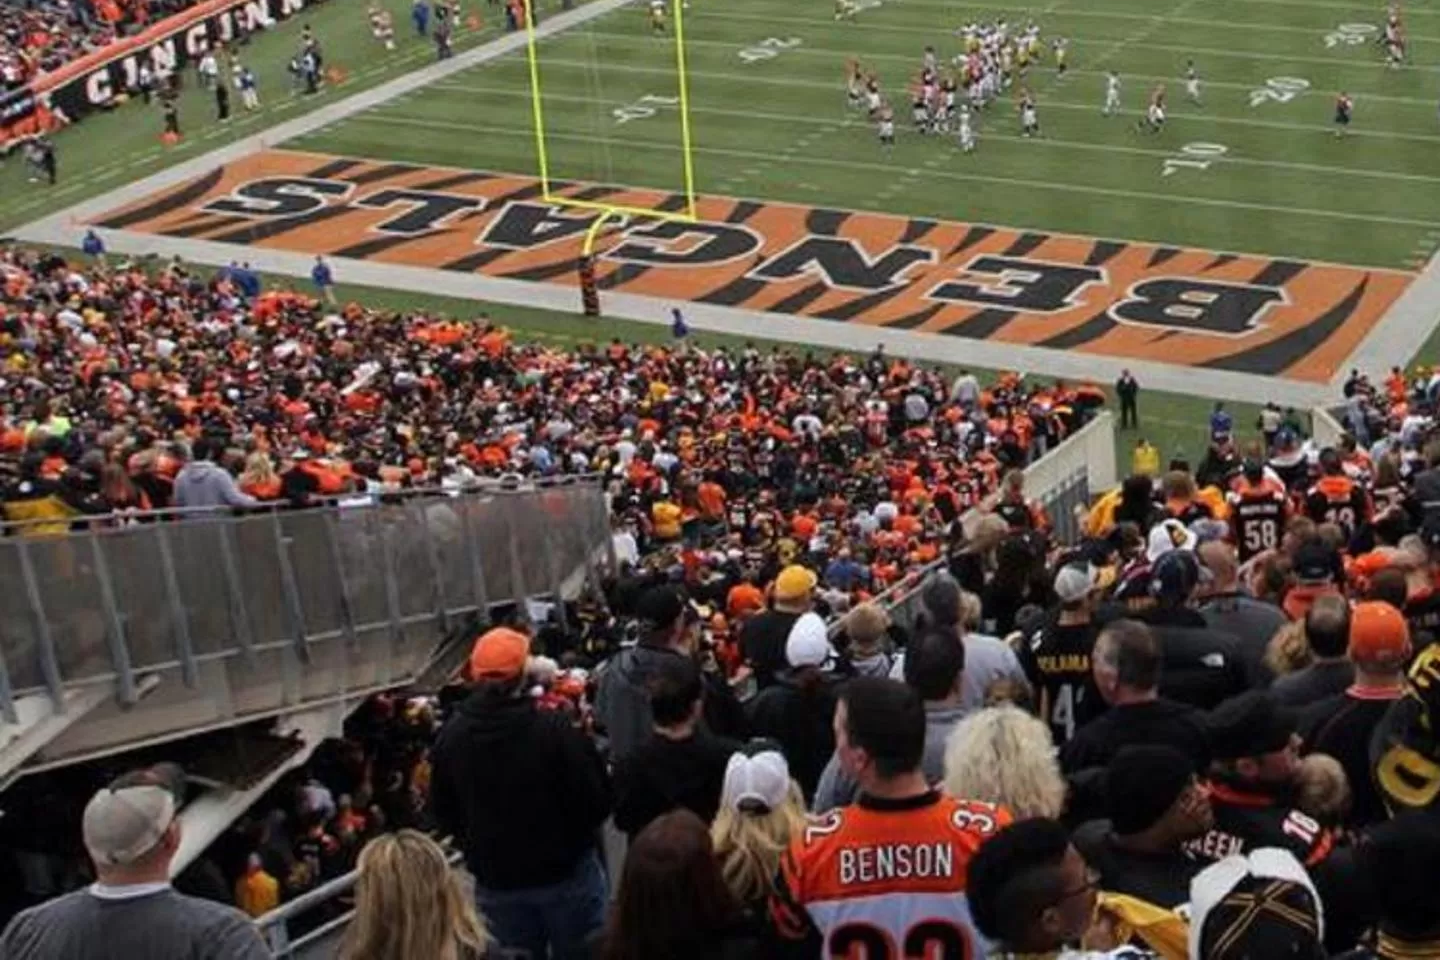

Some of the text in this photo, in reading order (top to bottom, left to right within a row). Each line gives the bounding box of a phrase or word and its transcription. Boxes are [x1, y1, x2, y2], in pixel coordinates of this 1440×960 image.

[1163, 142, 1229, 172] 10
[199, 176, 1293, 339] BENGALS
[1244, 520, 1276, 550] 58
[839, 843, 953, 885] BENSON
